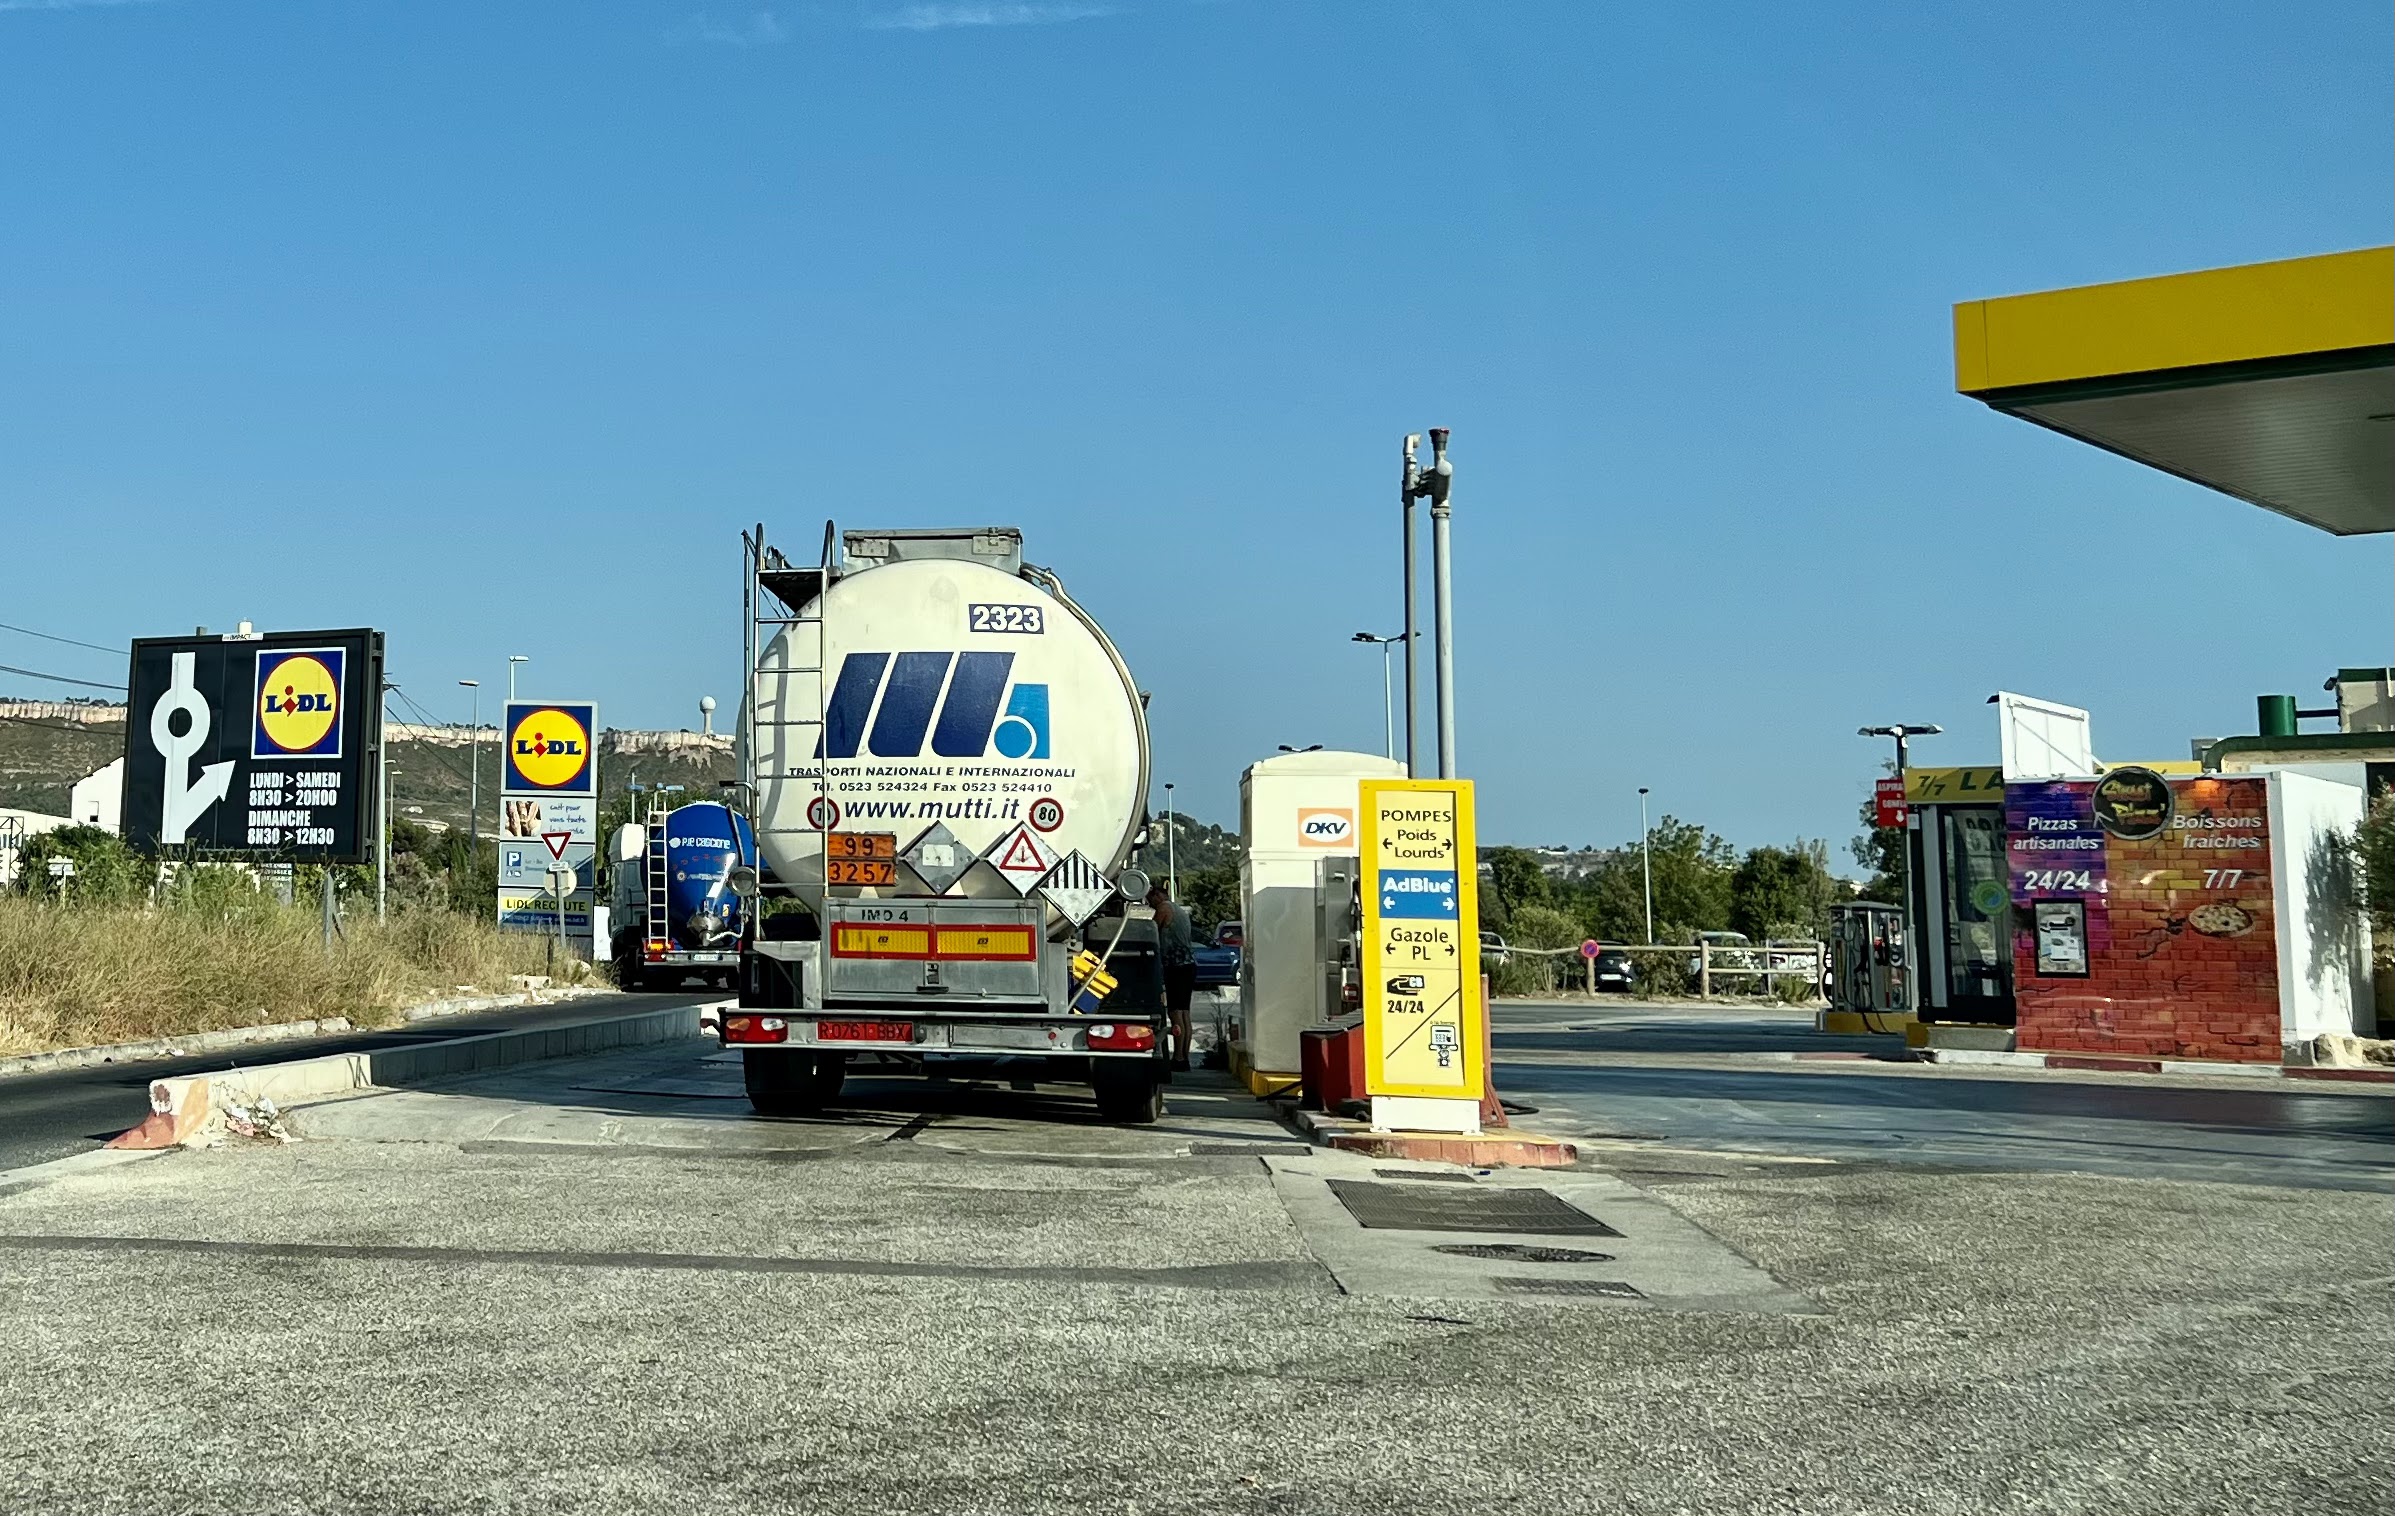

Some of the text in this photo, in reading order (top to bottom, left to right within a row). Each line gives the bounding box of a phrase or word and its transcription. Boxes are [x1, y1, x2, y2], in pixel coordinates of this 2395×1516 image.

[973, 605, 1041, 632] 2323
[249, 772, 285, 788] LUNDI
[295, 771, 341, 788] SAMEDI
[866, 766, 941, 776] NAZIONALI
[945, 767, 955, 776] E
[959, 767, 1075, 778] INTERNAZIONALI
[839, 782, 872, 791] 0523
[877, 782, 928, 791] 524324
[933, 782, 957, 792] Fax
[961, 782, 997, 792] 0523
[1001, 783, 1052, 793] 524410
[1918, 775, 1945, 797] 7/7
[248, 789, 282, 806] 8H30
[295, 789, 337, 806] 20H00
[844, 798, 1020, 819] www.mutti.it
[1038, 806, 1057, 822] 80
[1381, 810, 1452, 822] POMPES
[248, 810, 311, 827] DIMANCHE
[2027, 816, 2078, 831] Pizzas
[2172, 815, 2262, 830] Boissons
[247, 827, 280, 845] 8H30
[295, 827, 335, 845] 12H30
[1305, 822, 1347, 835] DKV
[1397, 829, 1437, 841] Poids
[845, 837, 874, 856] 99
[2013, 835, 2099, 850] artisanales
[1394, 847, 1445, 859] Lourds
[829, 862, 892, 883] 3257
[2023, 870, 2091, 891] 24/24
[2203, 869, 2243, 889] 7/7
[898, 910, 909, 922] 4
[1390, 927, 1449, 943] Gazole
[1412, 946, 1431, 960] PL
[1387, 1000, 1424, 1014] 24/24
